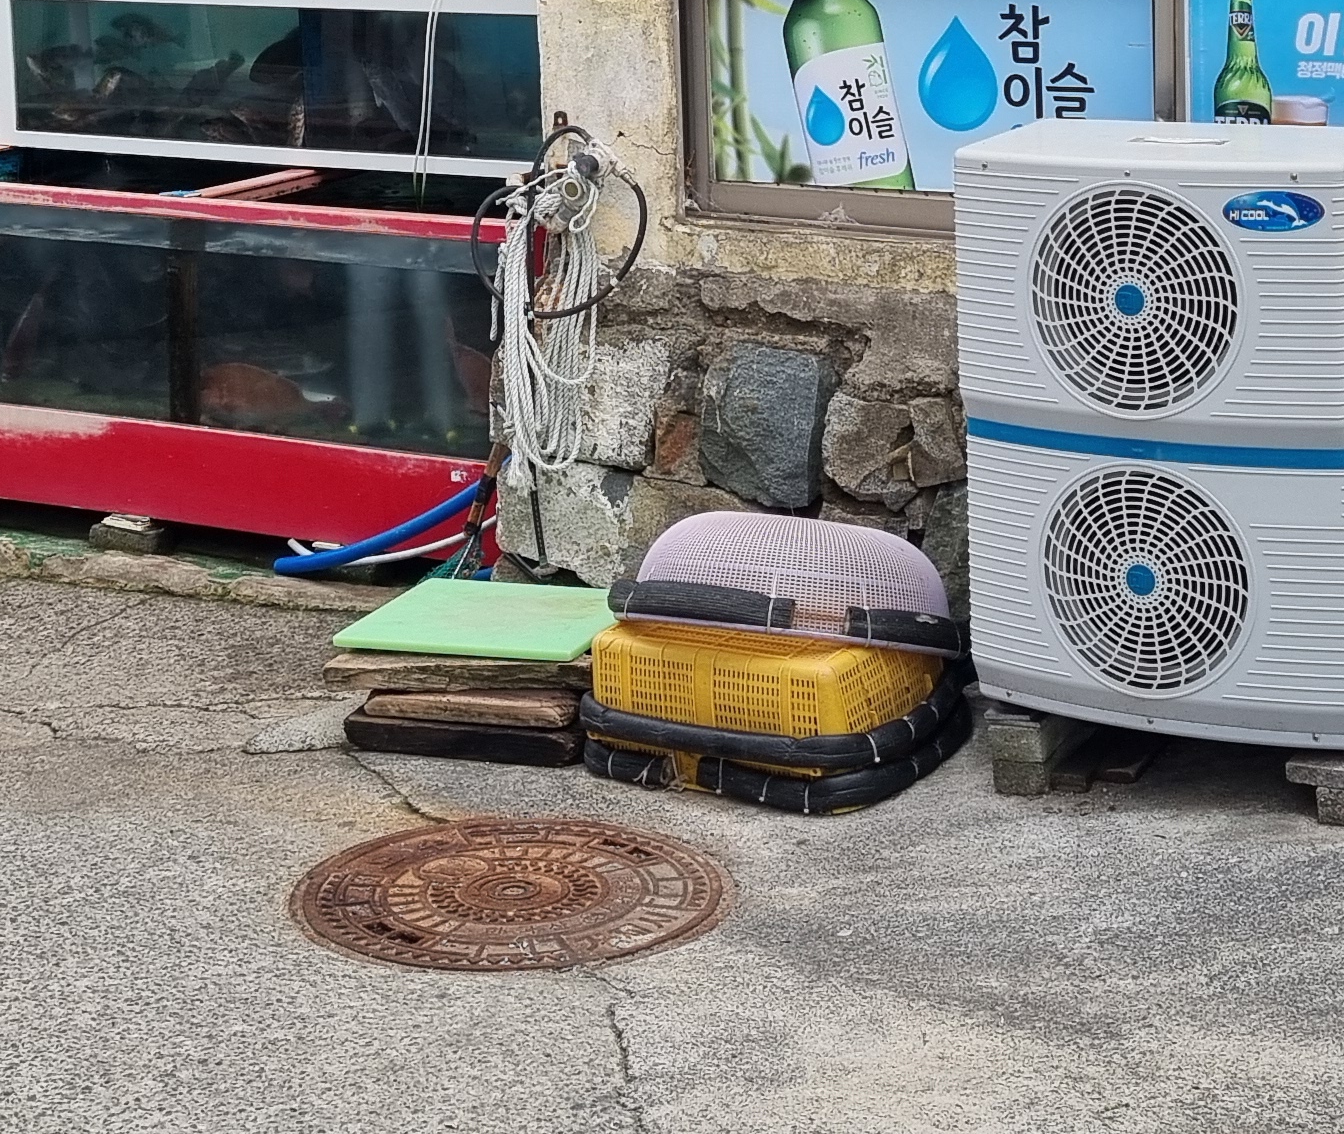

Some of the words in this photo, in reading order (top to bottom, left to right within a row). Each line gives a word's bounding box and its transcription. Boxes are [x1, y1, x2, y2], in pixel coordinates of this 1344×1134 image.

[998, 3, 1050, 64] 참
[1295, 13, 1341, 55] 이
[838, 78, 866, 112] 참
[1003, 62, 1095, 120] 이슬
[848, 106, 895, 140] 이슬
[857, 148, 896, 170] fresh
[1229, 209, 1239, 221] HI
[1241, 209, 1269, 221] COOL
